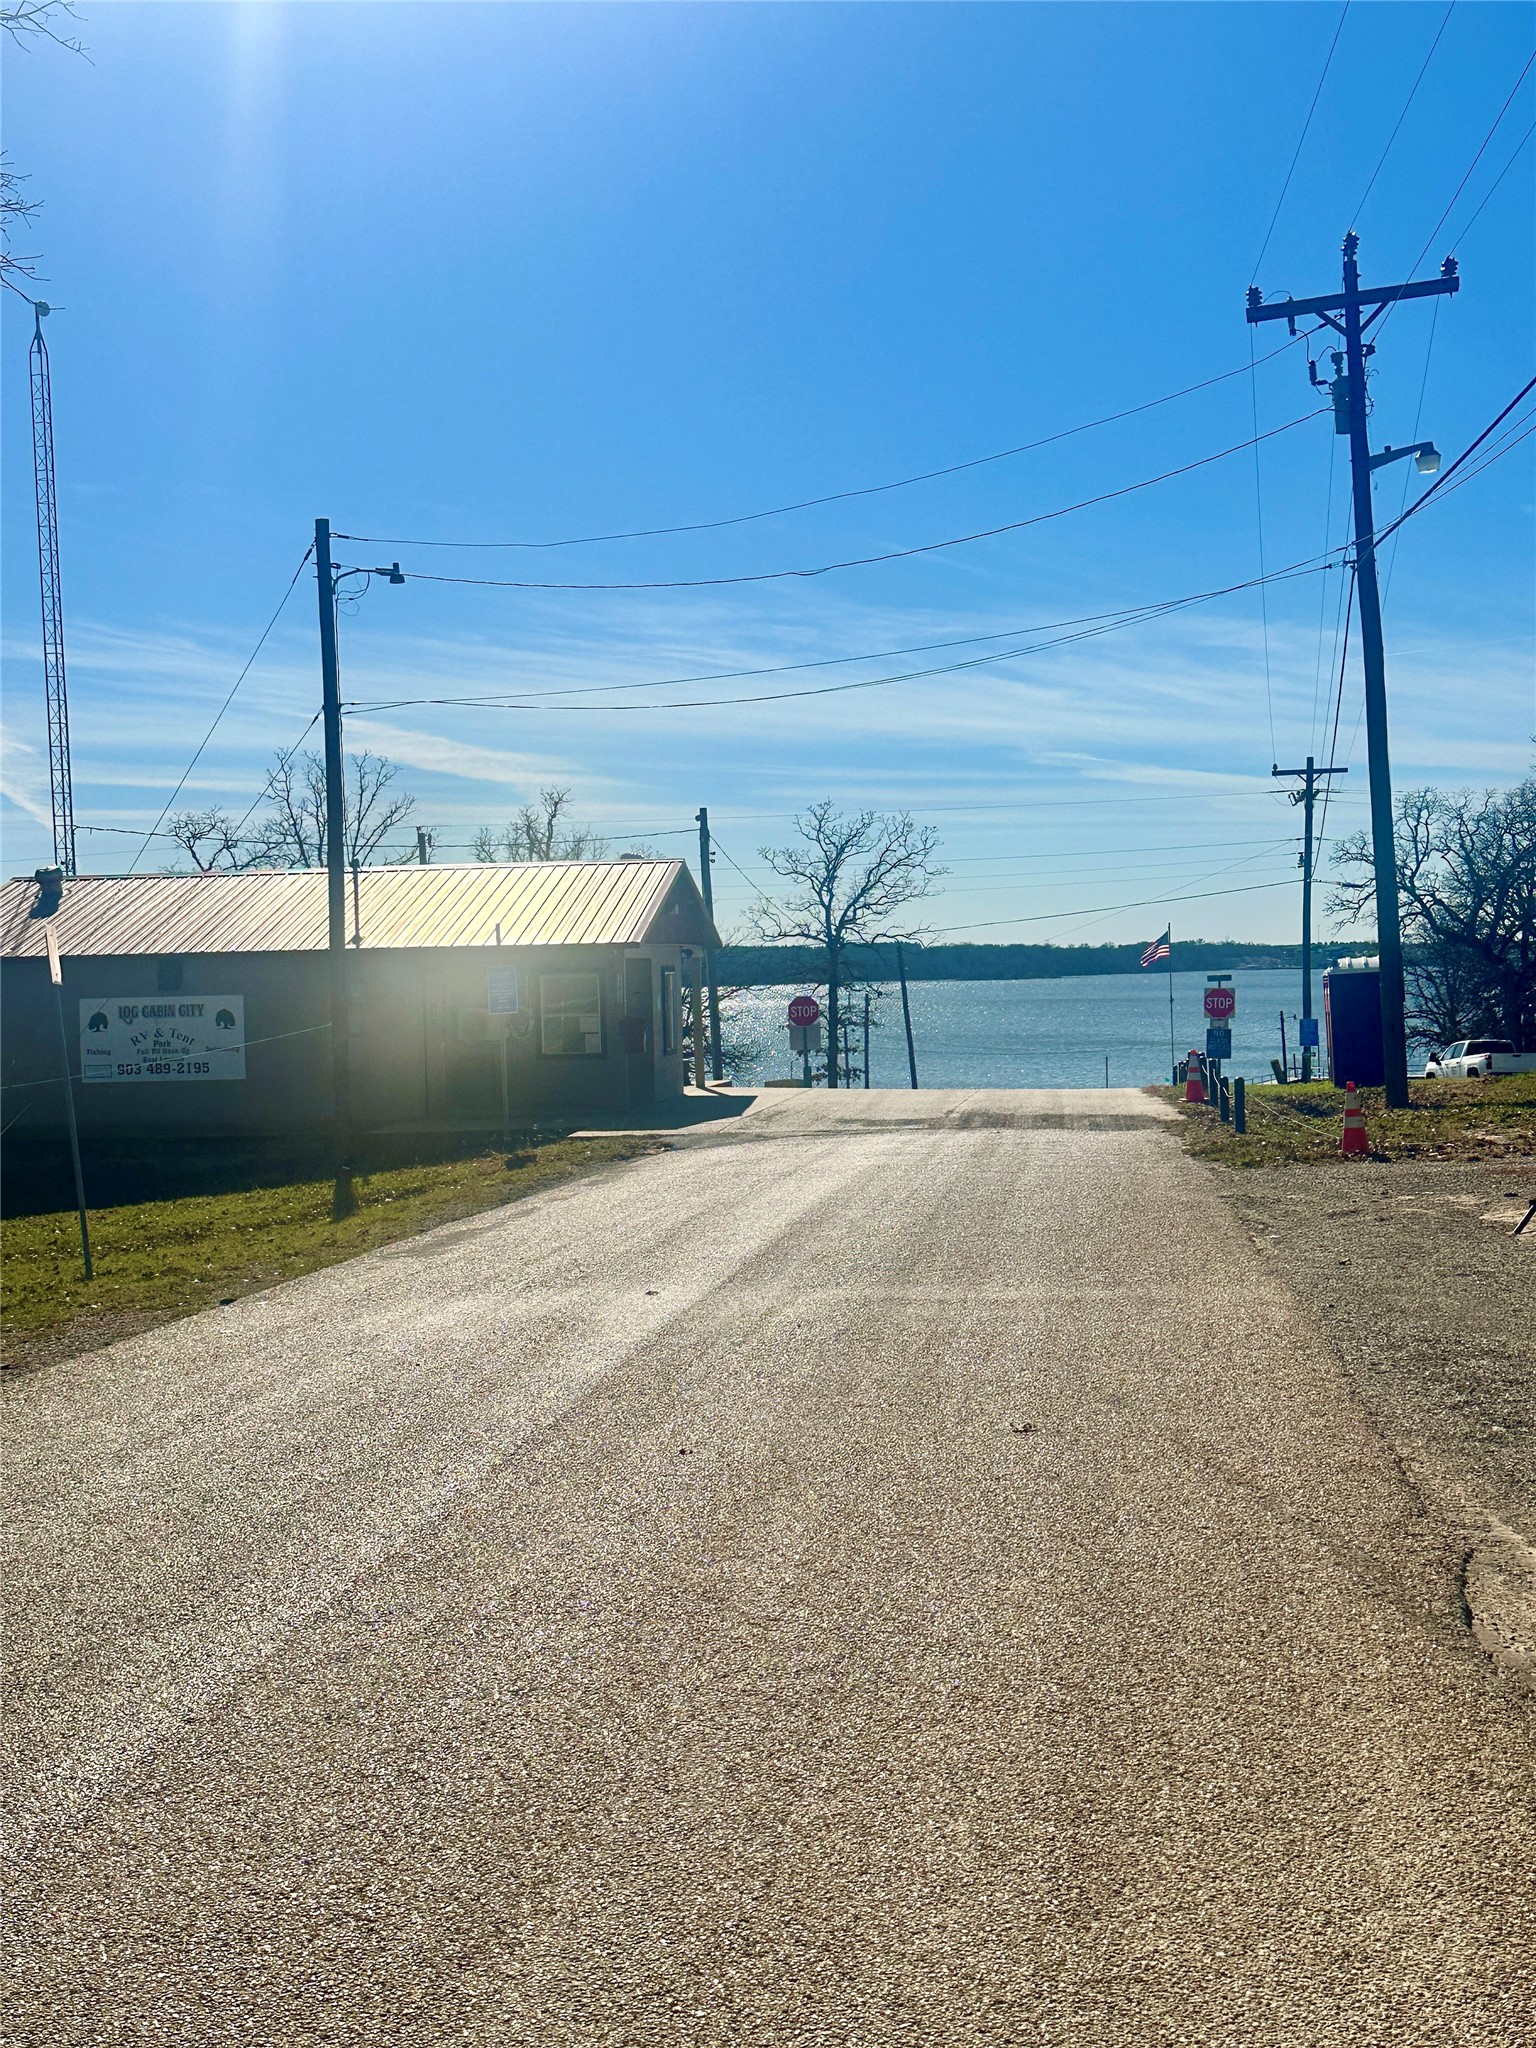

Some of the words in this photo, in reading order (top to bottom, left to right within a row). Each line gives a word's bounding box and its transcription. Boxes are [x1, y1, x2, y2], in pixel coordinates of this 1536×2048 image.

[1206, 997, 1233, 1009] STOP
[118, 1005, 139, 1024] LOG
[142, 1004, 176, 1018] CABIN
[178, 1003, 205, 1017] CITY
[790, 1005, 817, 1018] STOP
[130, 1032, 148, 1046] RV
[154, 1027, 164, 1038] &
[170, 1028, 195, 1046] Tent
[153, 1040, 171, 1048] Park
[86, 1048, 112, 1056] Fishing
[117, 1063, 142, 1076] 903
[146, 1062, 210, 1075] 489-2195
